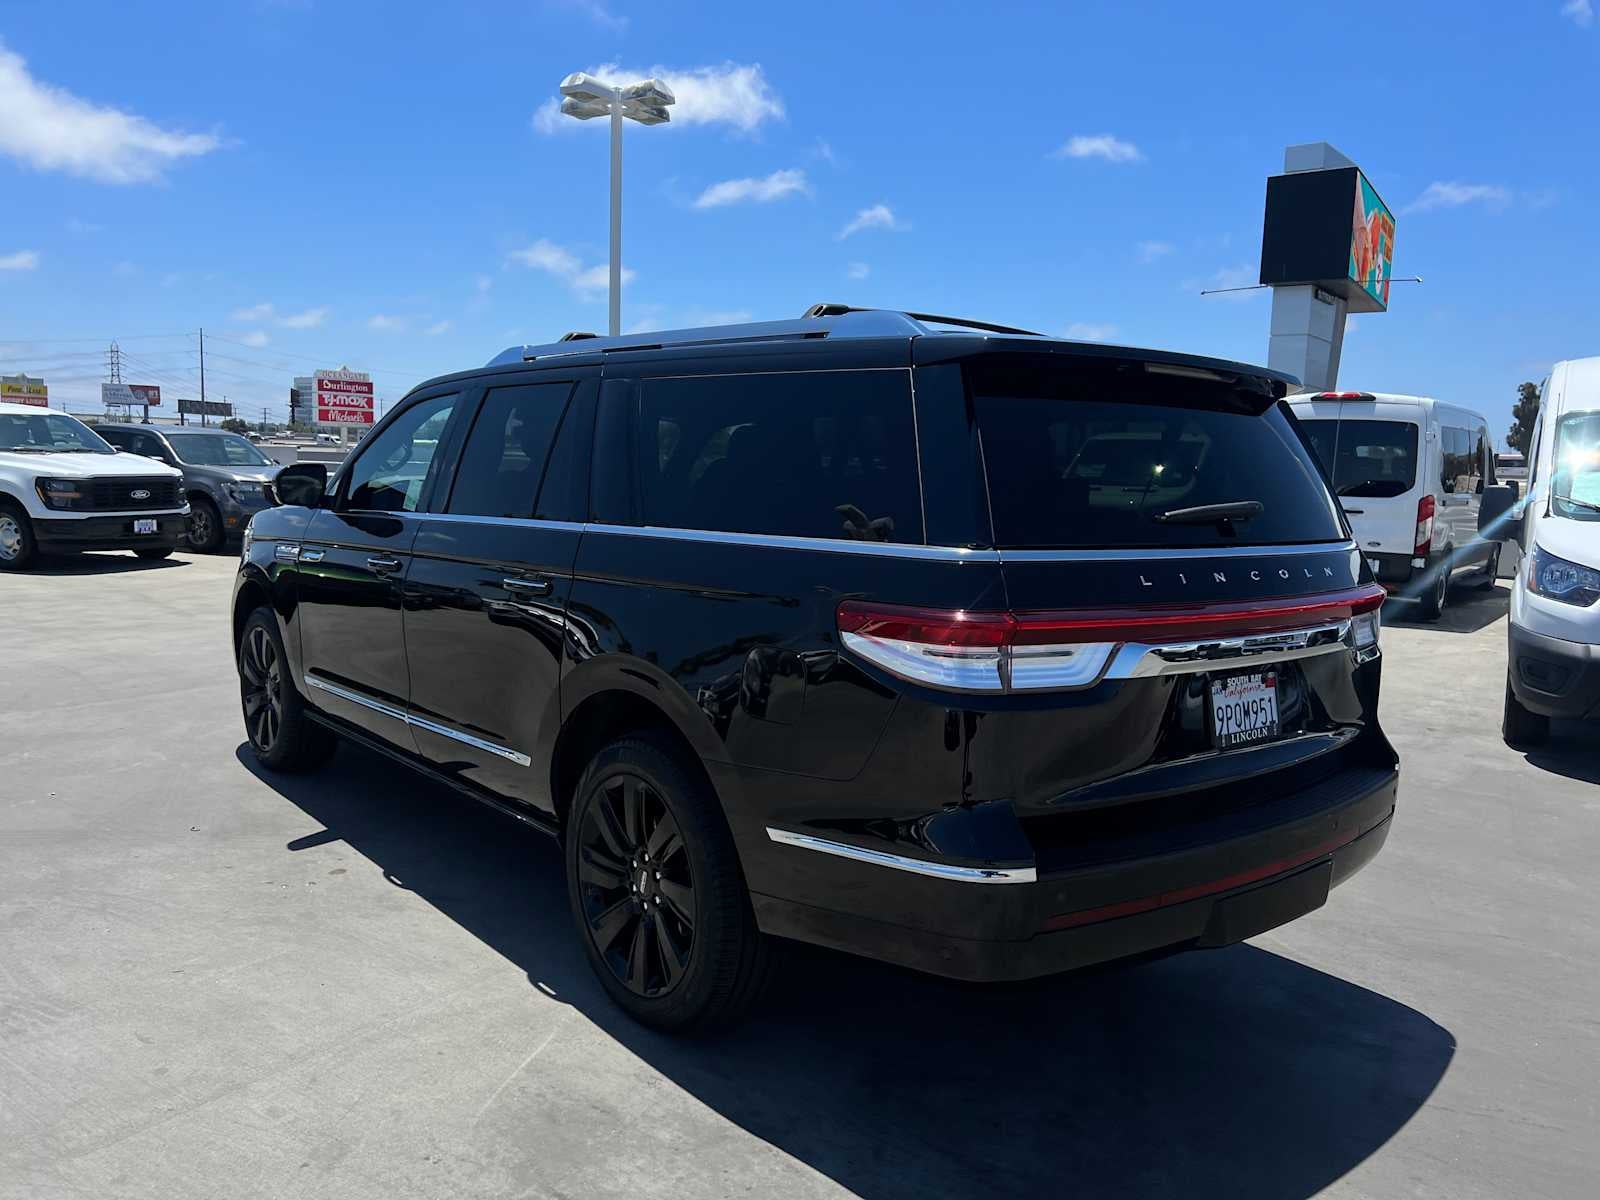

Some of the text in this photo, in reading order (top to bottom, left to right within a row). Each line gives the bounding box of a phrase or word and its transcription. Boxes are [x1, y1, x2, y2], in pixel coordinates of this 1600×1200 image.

[322, 380, 369, 392] Burlington
[1139, 567, 1334, 586] LINCOLN
[1227, 676, 1249, 687] SOUTH
[1231, 727, 1268, 744] LINCOLN
